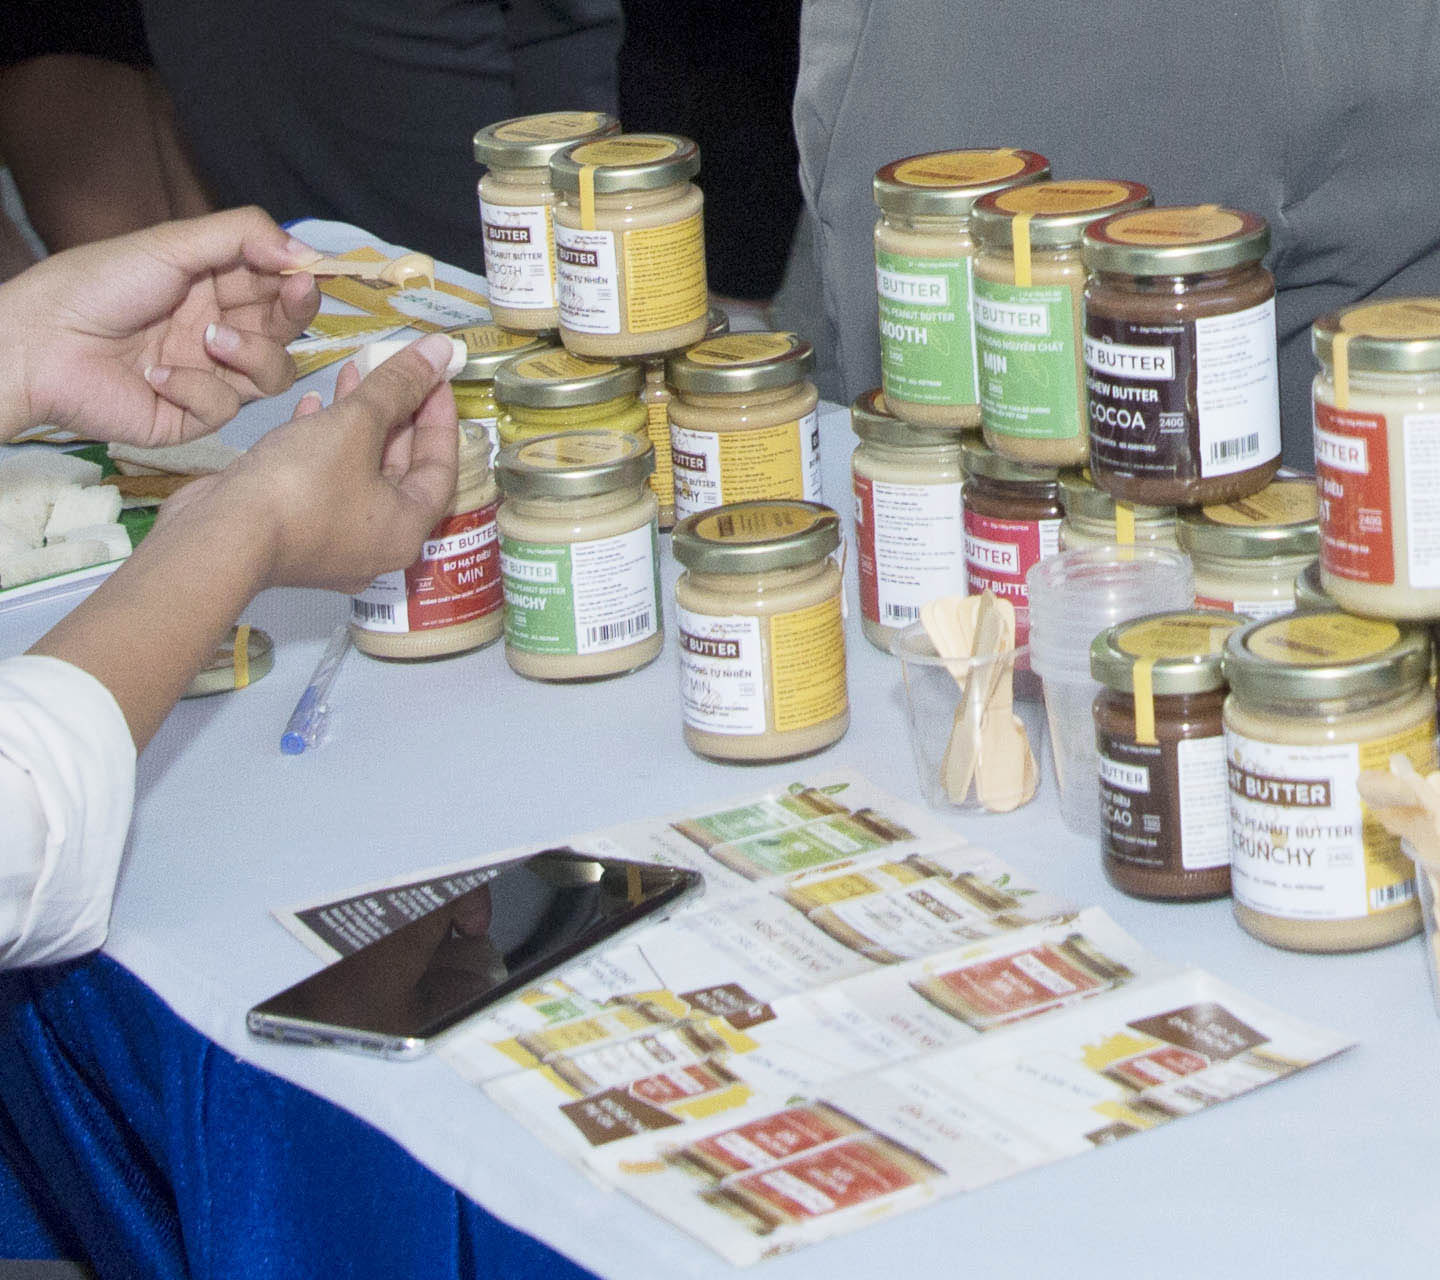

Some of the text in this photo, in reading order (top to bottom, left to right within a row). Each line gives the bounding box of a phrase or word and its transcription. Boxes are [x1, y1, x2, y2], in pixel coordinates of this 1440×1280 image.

[489, 227, 528, 241] BUTTER
[882, 276, 941, 298] BUTTER
[983, 306, 1041, 328] BUTTER
[1098, 351, 1165, 371] BUTTER
[1112, 385, 1158, 403] BUTTER
[1090, 401, 1146, 430] COCOA
[1160, 417, 1185, 429] 240G
[459, 524, 498, 549] BUTTER
[992, 580, 1029, 597] BUTTE
[689, 639, 736, 656] BUTTER
[1245, 776, 1326, 804] BUTTER
[1295, 824, 1353, 839] BUTTER
[1232, 829, 1316, 867] CRUNCHY
